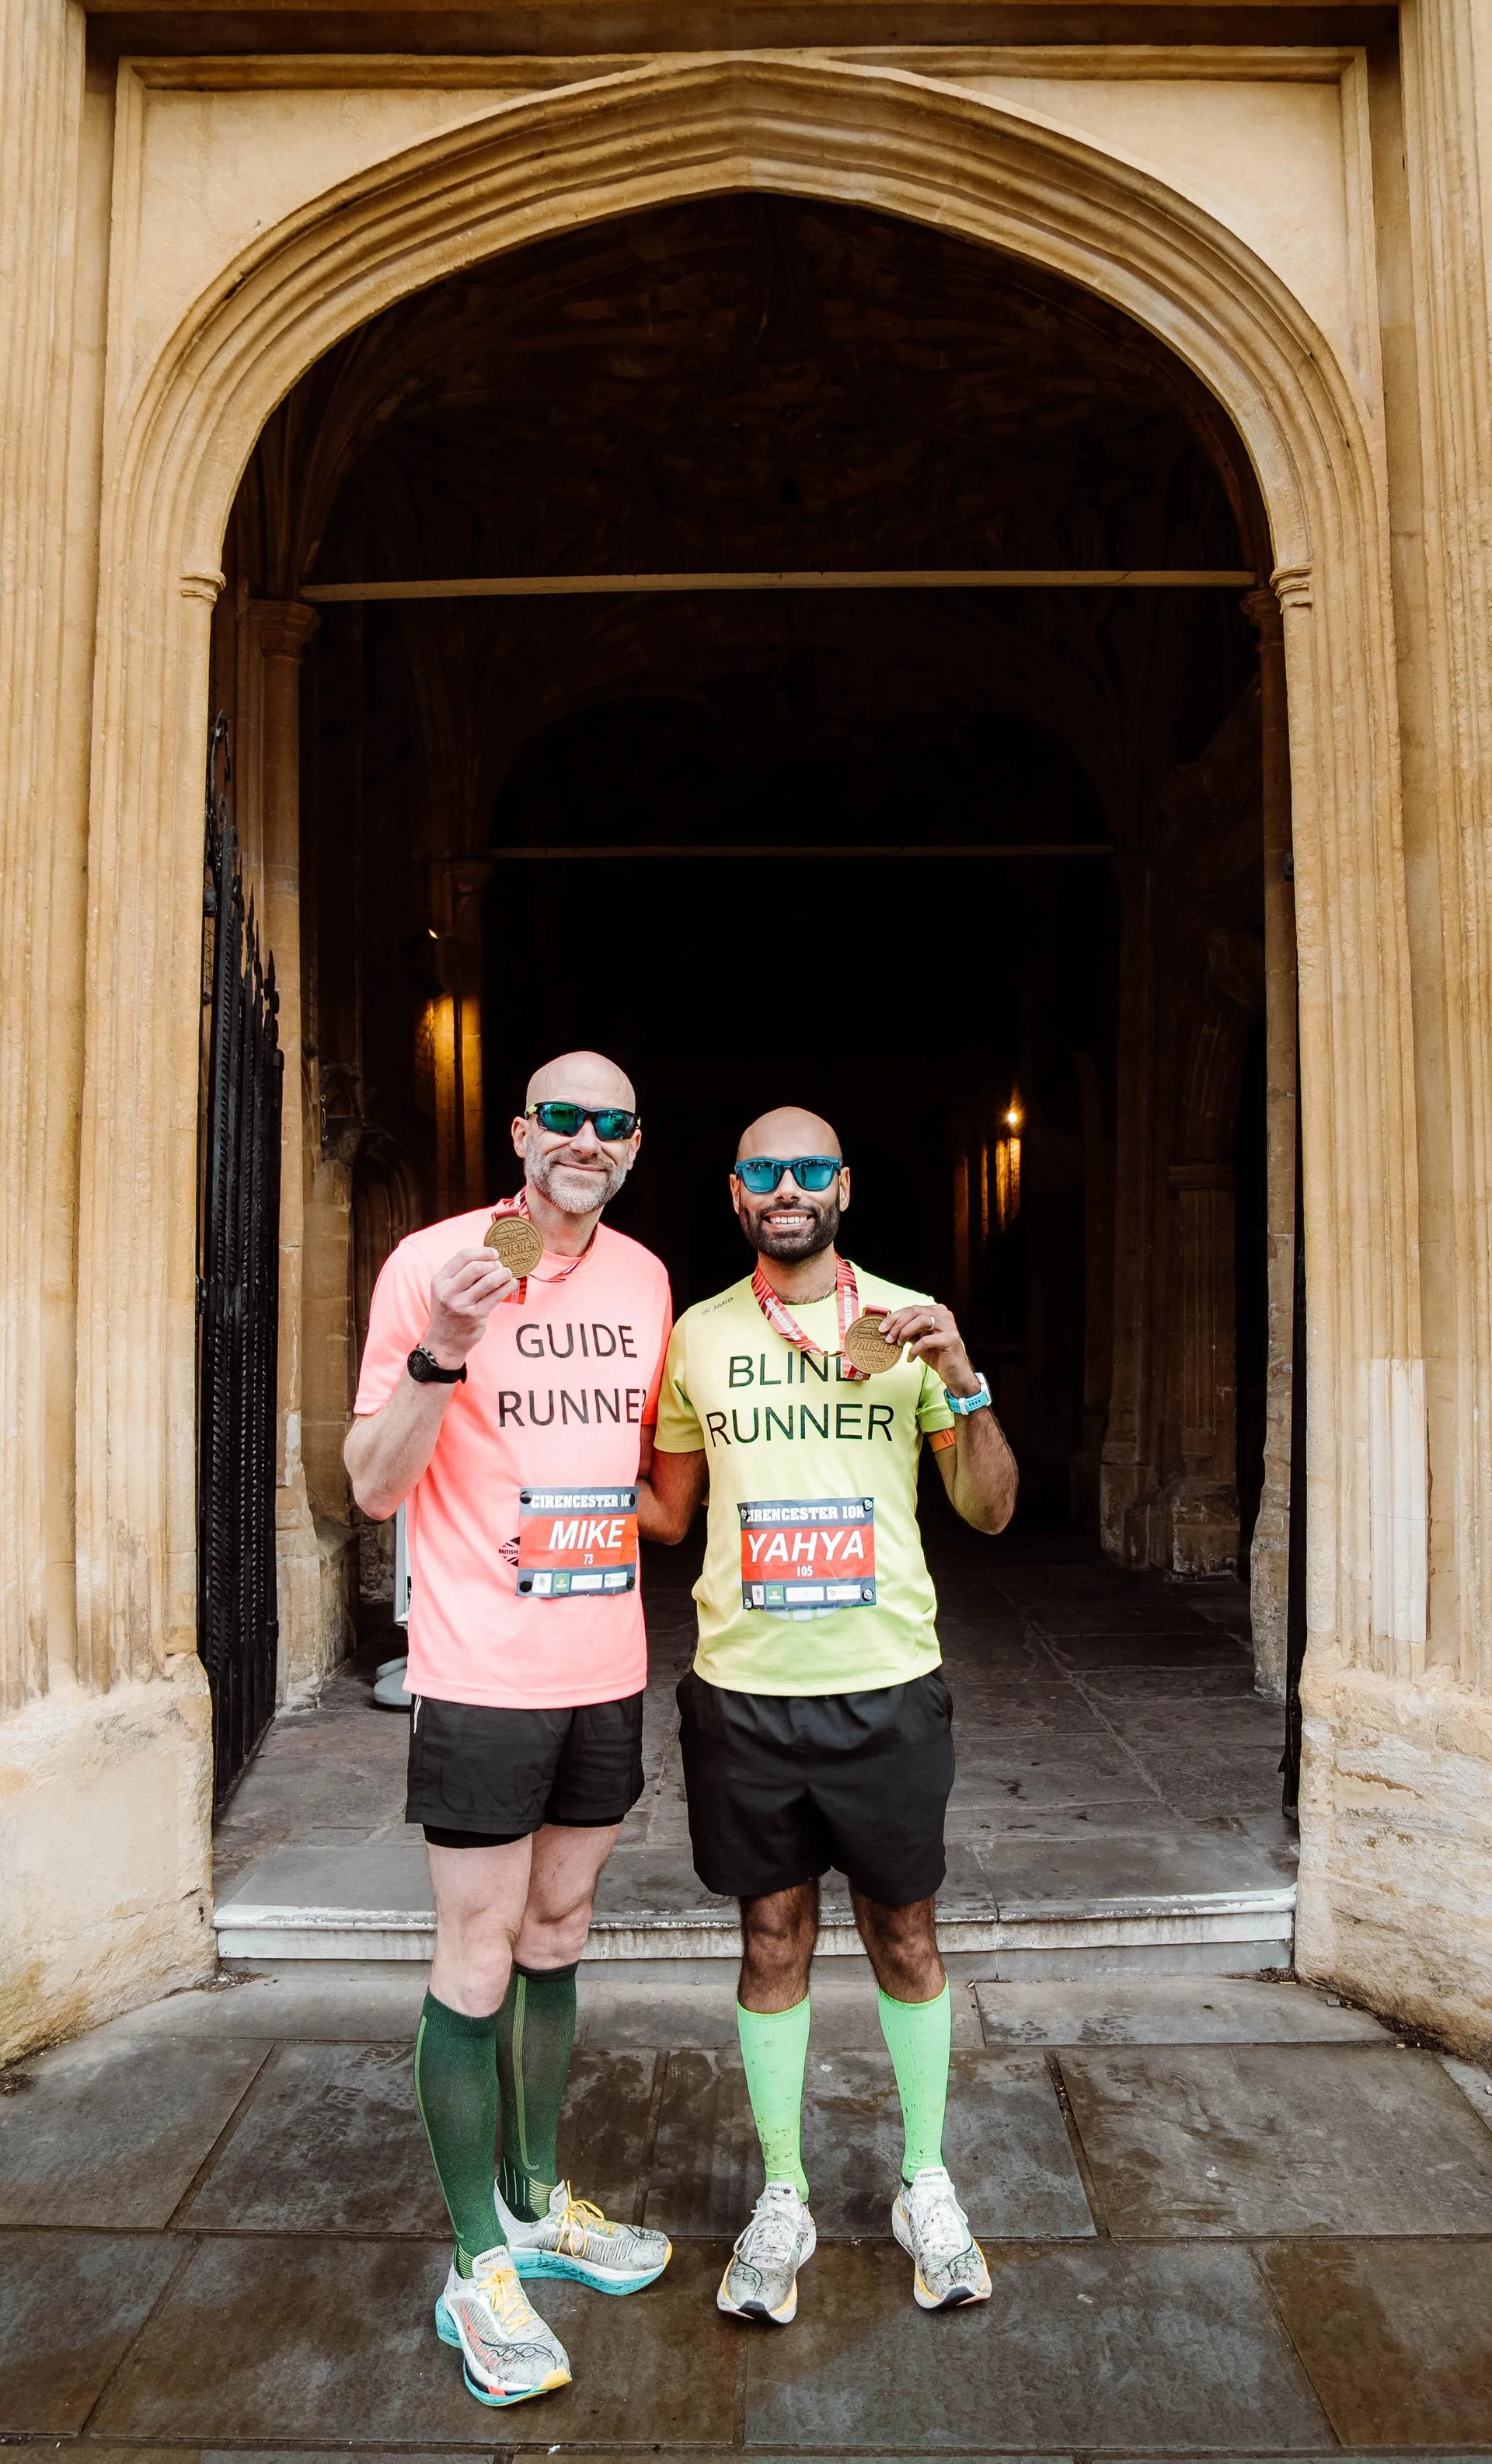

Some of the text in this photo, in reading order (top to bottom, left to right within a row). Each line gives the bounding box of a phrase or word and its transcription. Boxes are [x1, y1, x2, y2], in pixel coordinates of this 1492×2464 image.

[712, 1297, 734, 1311] JAKO
[515, 1323, 638, 1359] GUIDE
[851, 1340, 896, 1353] FINISHER
[706, 1403, 894, 1447] RUNNER
[531, 1494, 619, 1509] CIRENCESTER
[842, 1504, 866, 1520] 10K
[548, 1519, 626, 1550] MIKE
[748, 1529, 865, 1563] YAHYA
[584, 1553, 594, 1565] 73
[797, 1565, 814, 1577] 105
[479, 2249, 504, 2264] saucony
